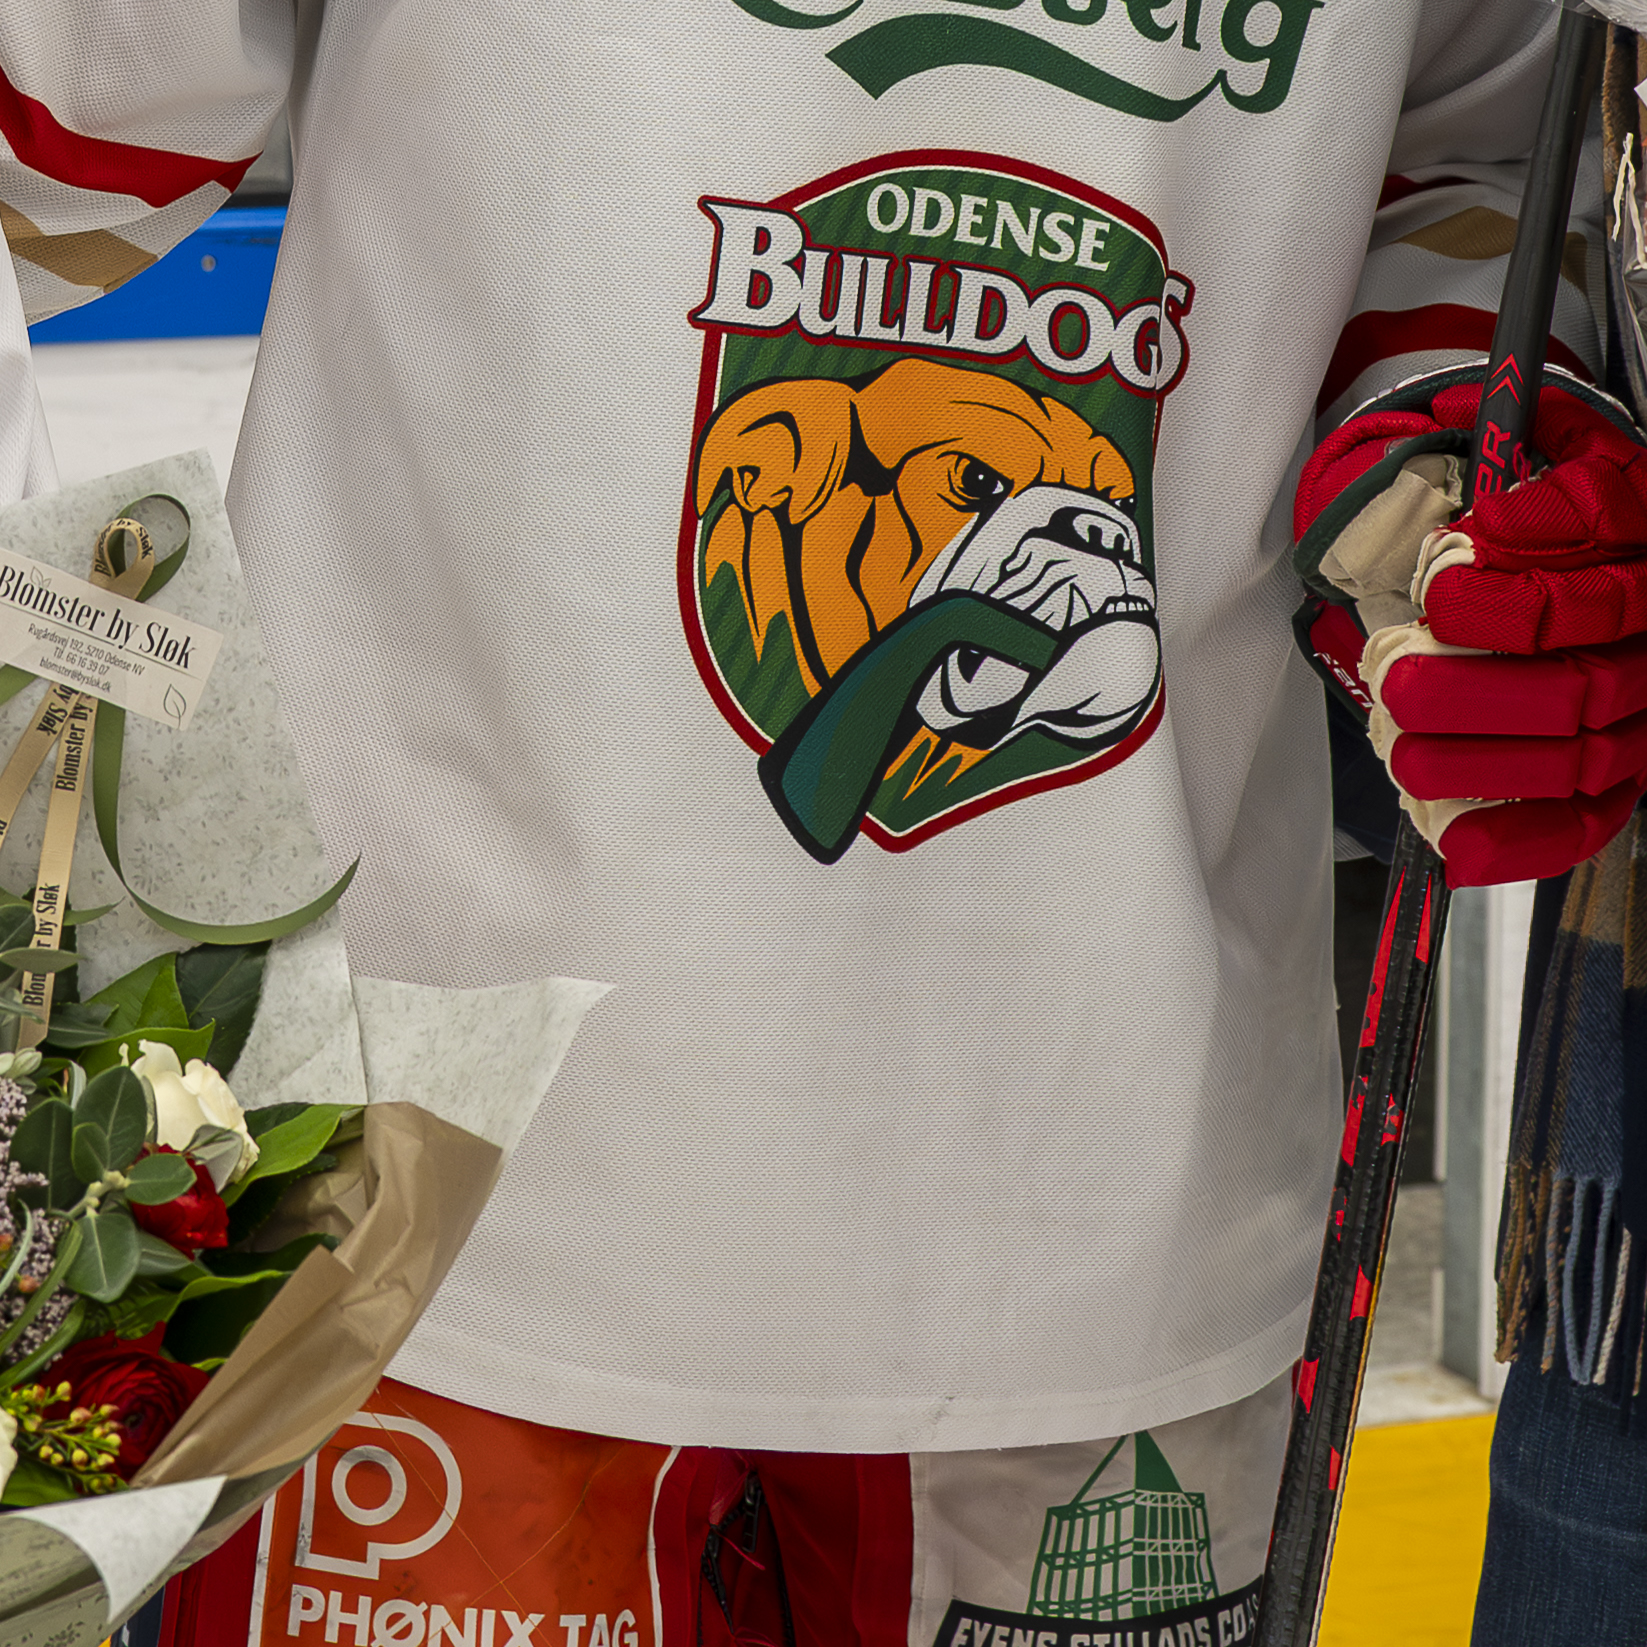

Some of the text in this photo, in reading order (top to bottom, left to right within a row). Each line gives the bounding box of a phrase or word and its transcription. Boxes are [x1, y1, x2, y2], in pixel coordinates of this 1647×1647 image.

[866, 181, 1112, 272] ODENSE
[104, 651, 133, 672] Odense
[106, 608, 139, 650] by
[139, 621, 197, 669] Sløk
[54, 723, 86, 792] Blomster
[34, 914, 59, 938] by
[35, 882, 61, 916] Sløk
[286, 1583, 546, 1647] PHØNIX
